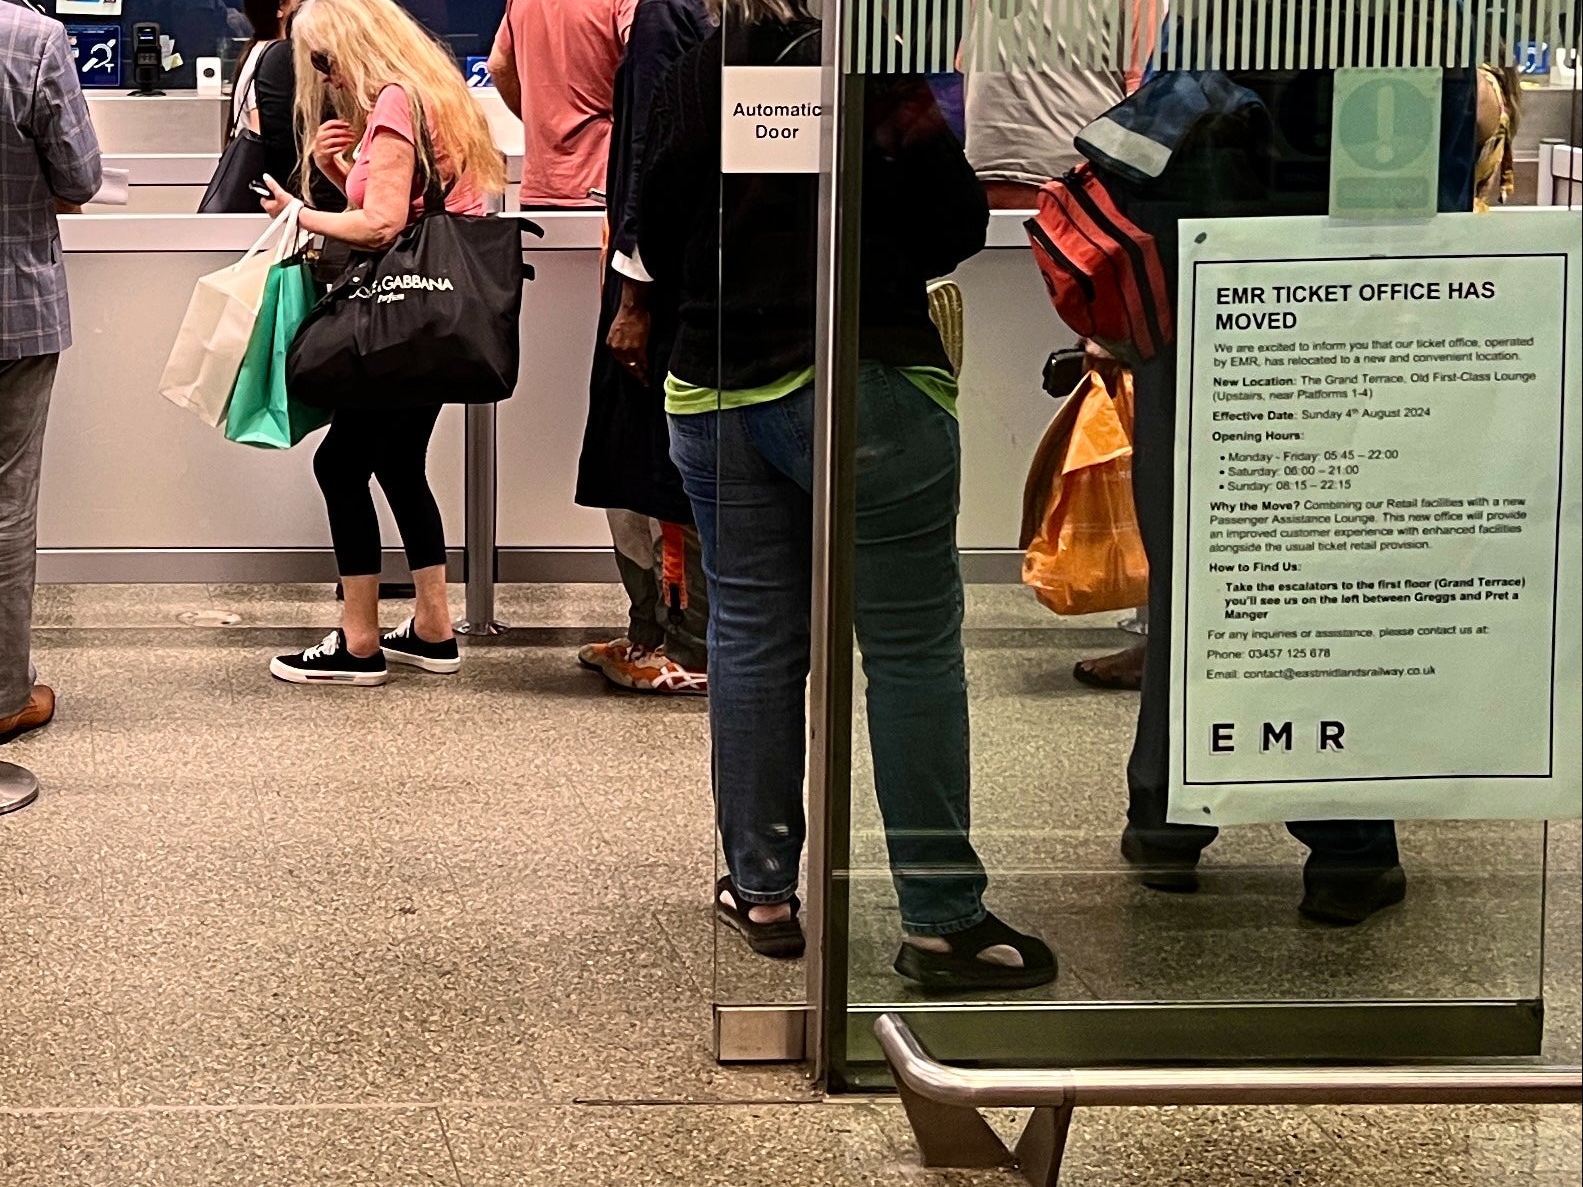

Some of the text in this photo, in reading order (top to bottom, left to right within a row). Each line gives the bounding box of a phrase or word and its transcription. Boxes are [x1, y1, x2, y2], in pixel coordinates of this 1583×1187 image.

[733, 102, 823, 117] Automatic
[755, 124, 800, 139] Door
[381, 274, 454, 291] GABBANA
[1217, 282, 1494, 304] EMR TICKET OFFICE HAS
[1216, 312, 1296, 329] MOVED
[1213, 375, 1238, 386] New
[1212, 408, 1264, 420] Effective
[1212, 430, 1262, 444] Opening
[1210, 500, 1236, 514] Why
[1239, 499, 1257, 510] the
[1262, 498, 1300, 510] Move?
[1209, 561, 1234, 572] How
[1238, 561, 1249, 571] to
[1253, 560, 1279, 571] Find
[1226, 576, 1525, 591] Take the escalators to the first floor (Grand Terrace)
[1260, 596, 1280, 604] see
[1284, 596, 1298, 604] us
[1301, 595, 1316, 604] on
[1319, 592, 1337, 604] the
[1341, 592, 1359, 603] left
[1362, 591, 1410, 603] between
[1414, 591, 1456, 605] Greggs
[1460, 590, 1481, 601] and
[1485, 590, 1508, 601] Pret
[1512, 592, 1518, 601] a
[1224, 608, 1268, 622] Manger
[1212, 720, 1346, 752] EMR
